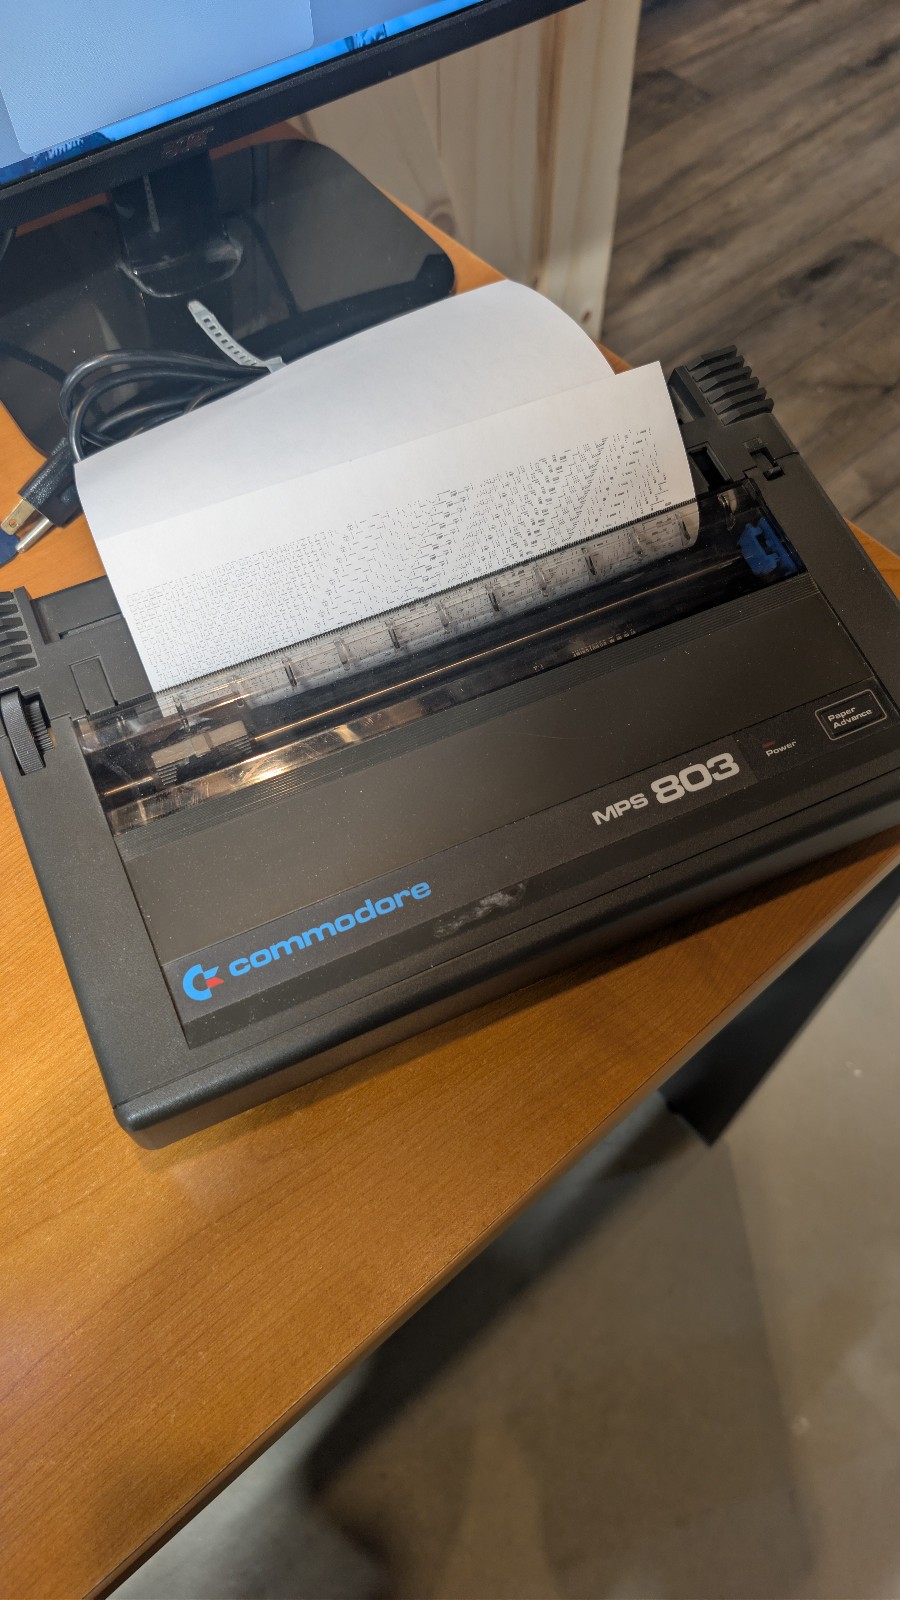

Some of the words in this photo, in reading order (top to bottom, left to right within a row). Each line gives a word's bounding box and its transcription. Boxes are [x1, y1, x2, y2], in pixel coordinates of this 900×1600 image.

[827, 706, 856, 722] Paper
[832, 708, 873, 729] Advance
[765, 740, 798, 757] Power
[591, 793, 649, 826] MPS
[650, 752, 740, 804] 803
[228, 881, 431, 977] commodore
